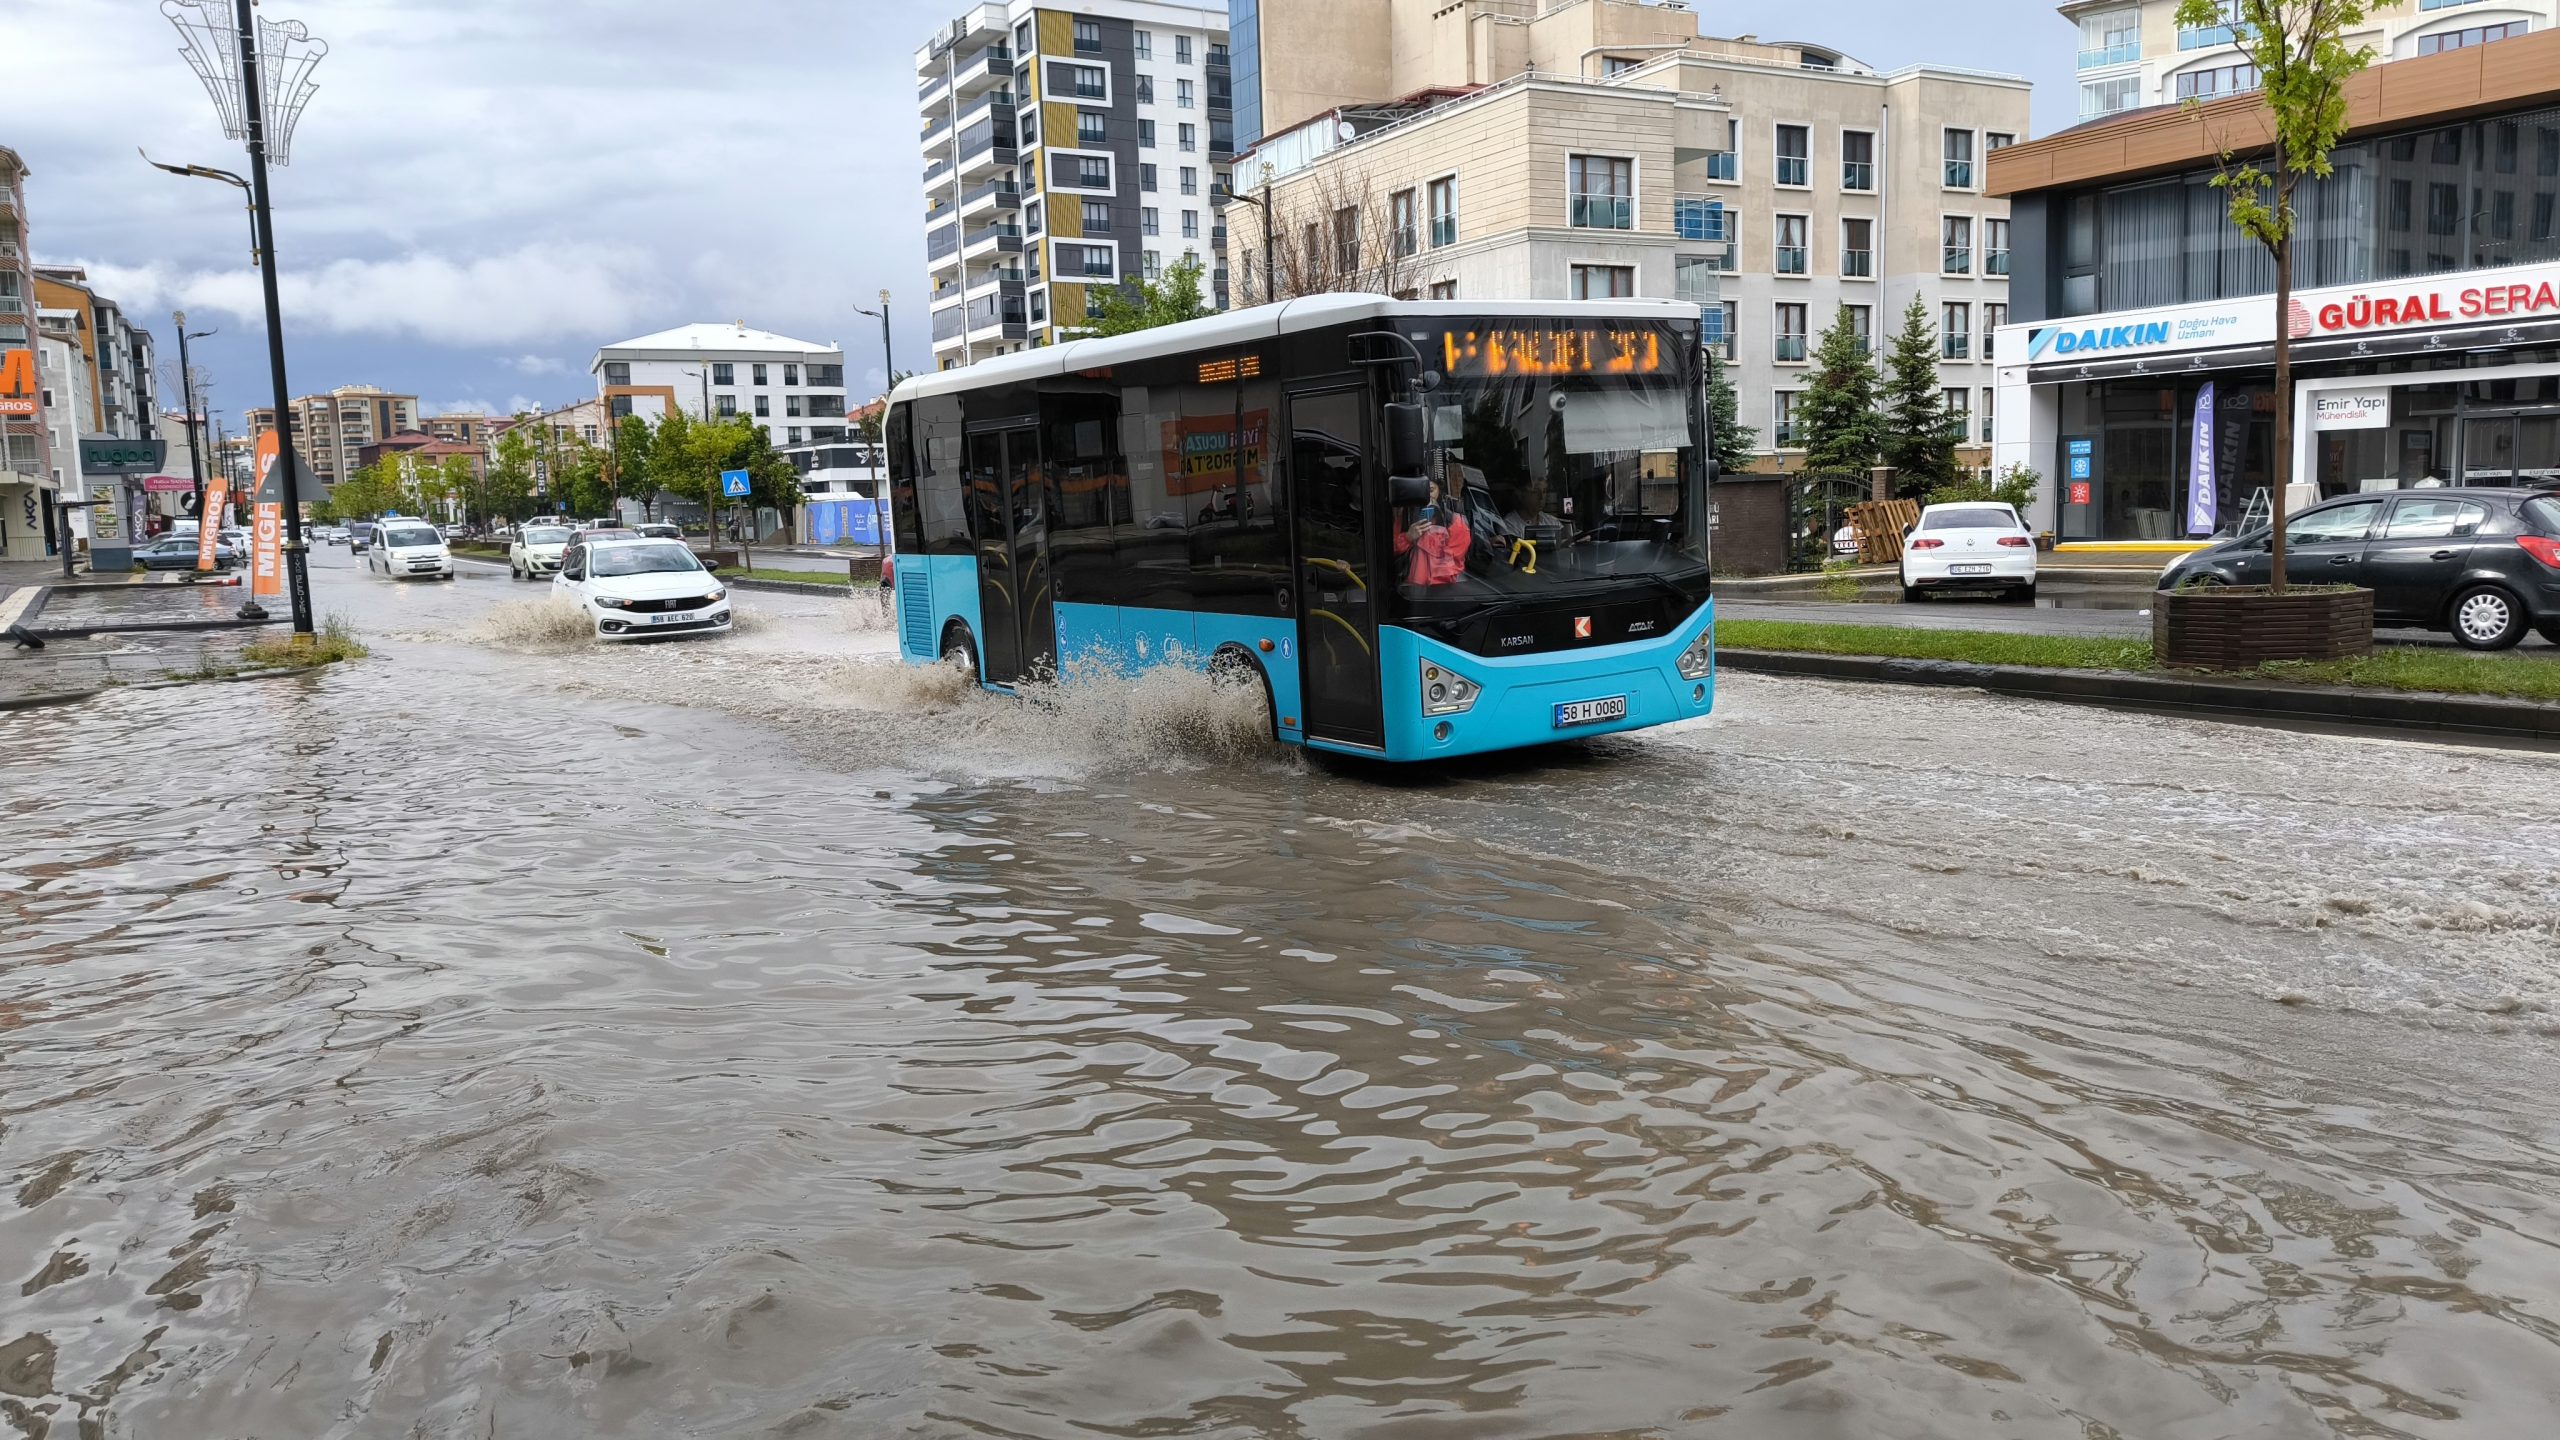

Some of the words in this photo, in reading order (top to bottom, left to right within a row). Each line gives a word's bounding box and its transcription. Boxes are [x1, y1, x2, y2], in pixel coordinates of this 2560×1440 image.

[2319, 293, 2451, 331] GÜRAL
[2459, 281, 2560, 318] SERA
[2179, 318, 2209, 331] Doğru
[2211, 316, 2237, 326] Hava
[2055, 321, 2170, 354] DAIKIN
[2178, 330, 2215, 340] Uzmanı
[2318, 398, 2350, 411] Emir
[2354, 396, 2385, 411] Yapı
[2316, 410, 2368, 420] Mühendislik
[2198, 422, 2210, 506] DAIKIN
[257, 452, 277, 578] MiGRS
[202, 490, 222, 560] MiGROS
[664, 600, 676, 609] FIAT
[1628, 620, 1654, 632] ATAK
[1501, 635, 1534, 648] KARSAN
[1564, 706, 1577, 720] 58
[1583, 704, 1591, 718] H
[1596, 700, 1623, 716] 0080
